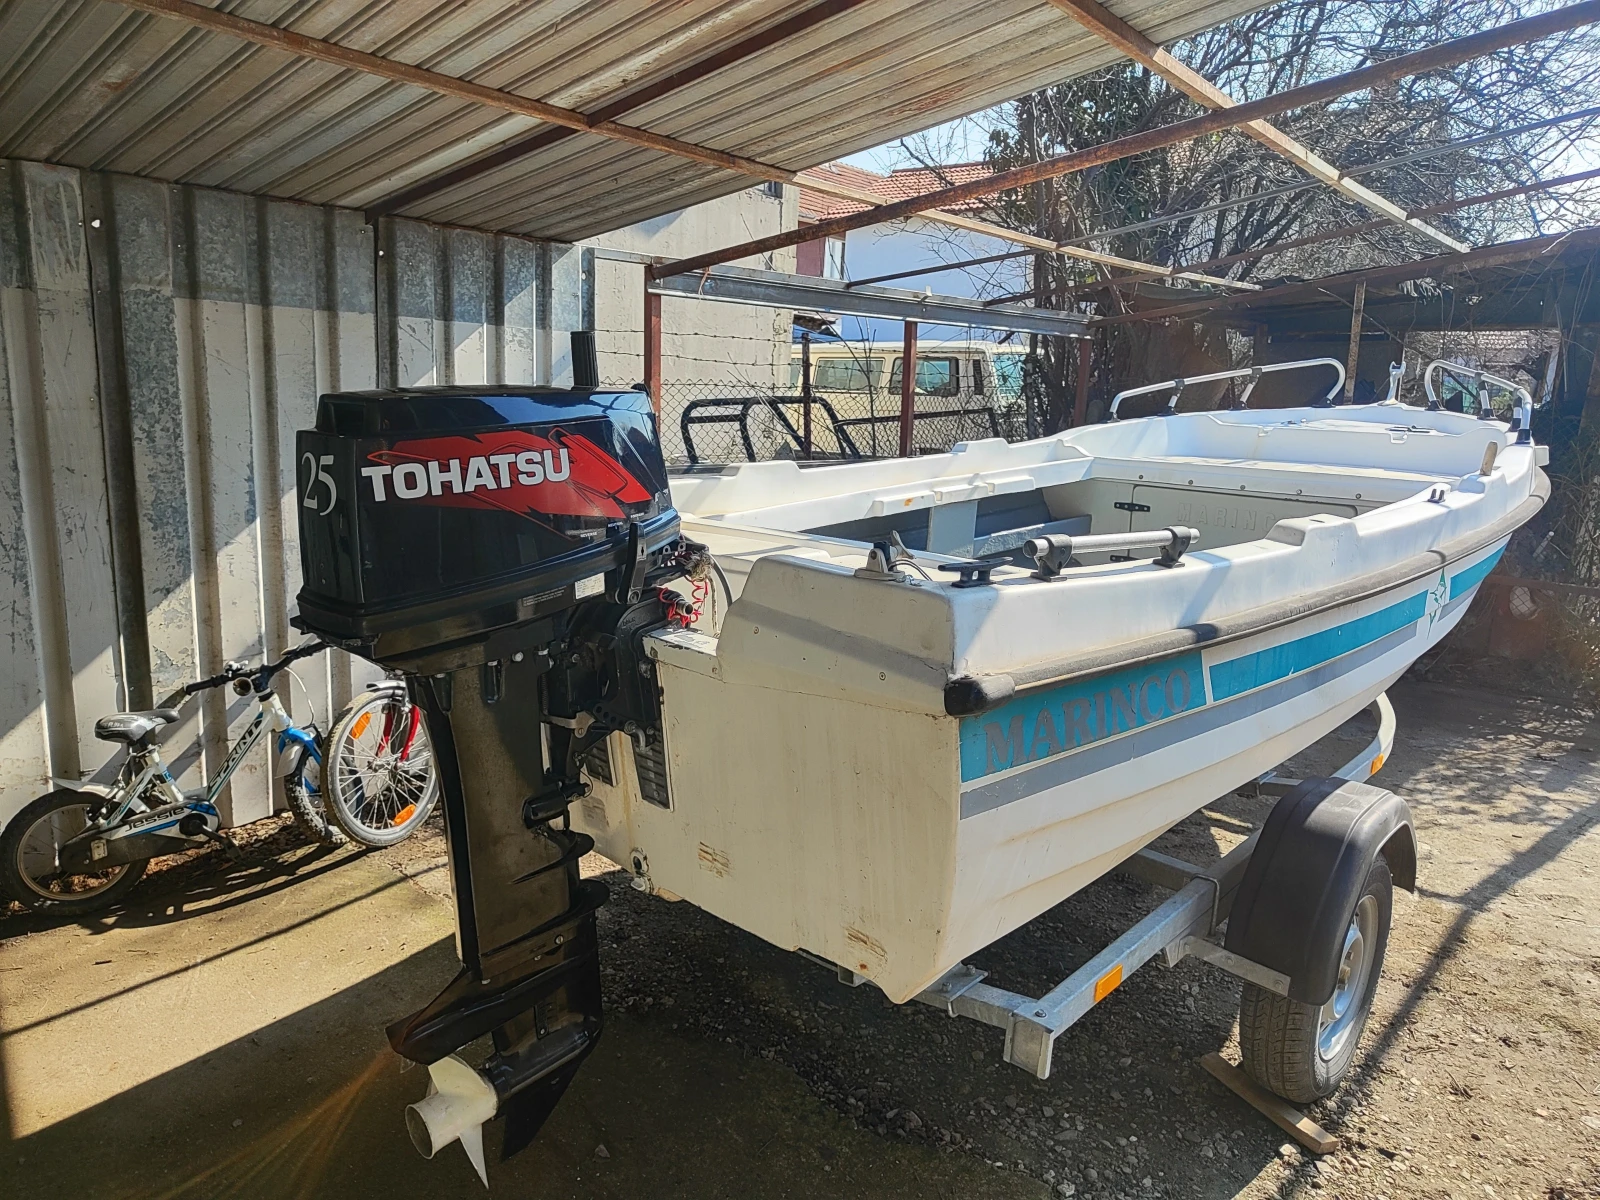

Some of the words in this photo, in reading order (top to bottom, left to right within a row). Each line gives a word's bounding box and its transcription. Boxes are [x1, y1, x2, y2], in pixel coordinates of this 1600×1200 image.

[301, 450, 337, 516] 25
[361, 447, 571, 502] TOHATSU
[1177, 502, 1277, 532] MARINC
[983, 668, 1192, 775] MARINCO
[208, 720, 260, 790] SPRINT
